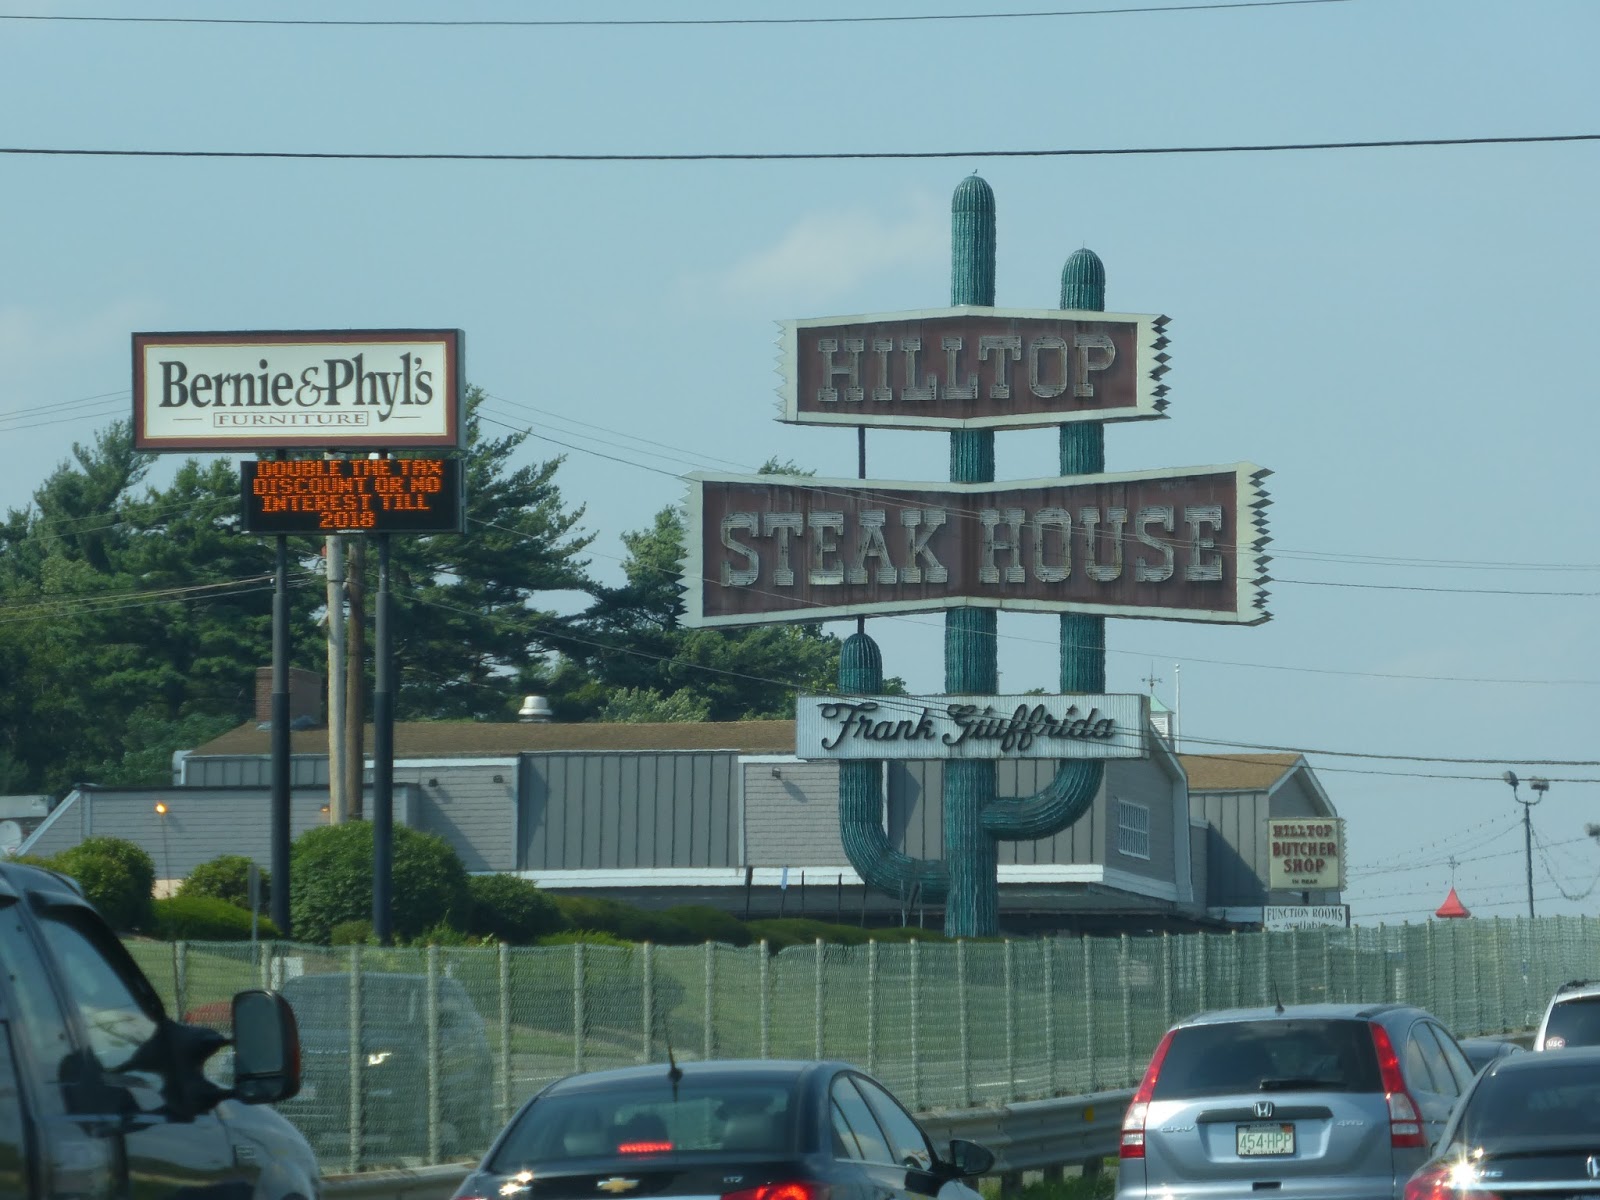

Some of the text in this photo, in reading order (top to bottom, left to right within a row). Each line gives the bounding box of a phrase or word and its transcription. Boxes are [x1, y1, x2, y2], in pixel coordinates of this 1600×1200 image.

[817, 334, 1115, 402] HILLTOP
[219, 413, 365, 425] FURNITURE
[257, 459, 443, 477] DOUBLE THE TAX
[253, 476, 441, 495] DISCOUNT OR NO
[262, 493, 431, 512] INTEREST TILL
[319, 511, 375, 528] 2018
[720, 504, 1223, 588] STEAK HOUSE
[816, 702, 1116, 752] Frank Giuffrida
[1273, 824, 1333, 837] HILLTOP
[1272, 842, 1337, 857] BUTCHER
[1283, 858, 1325, 873] SHOP
[1267, 907, 1342, 922] FUNCTION ROOMS
